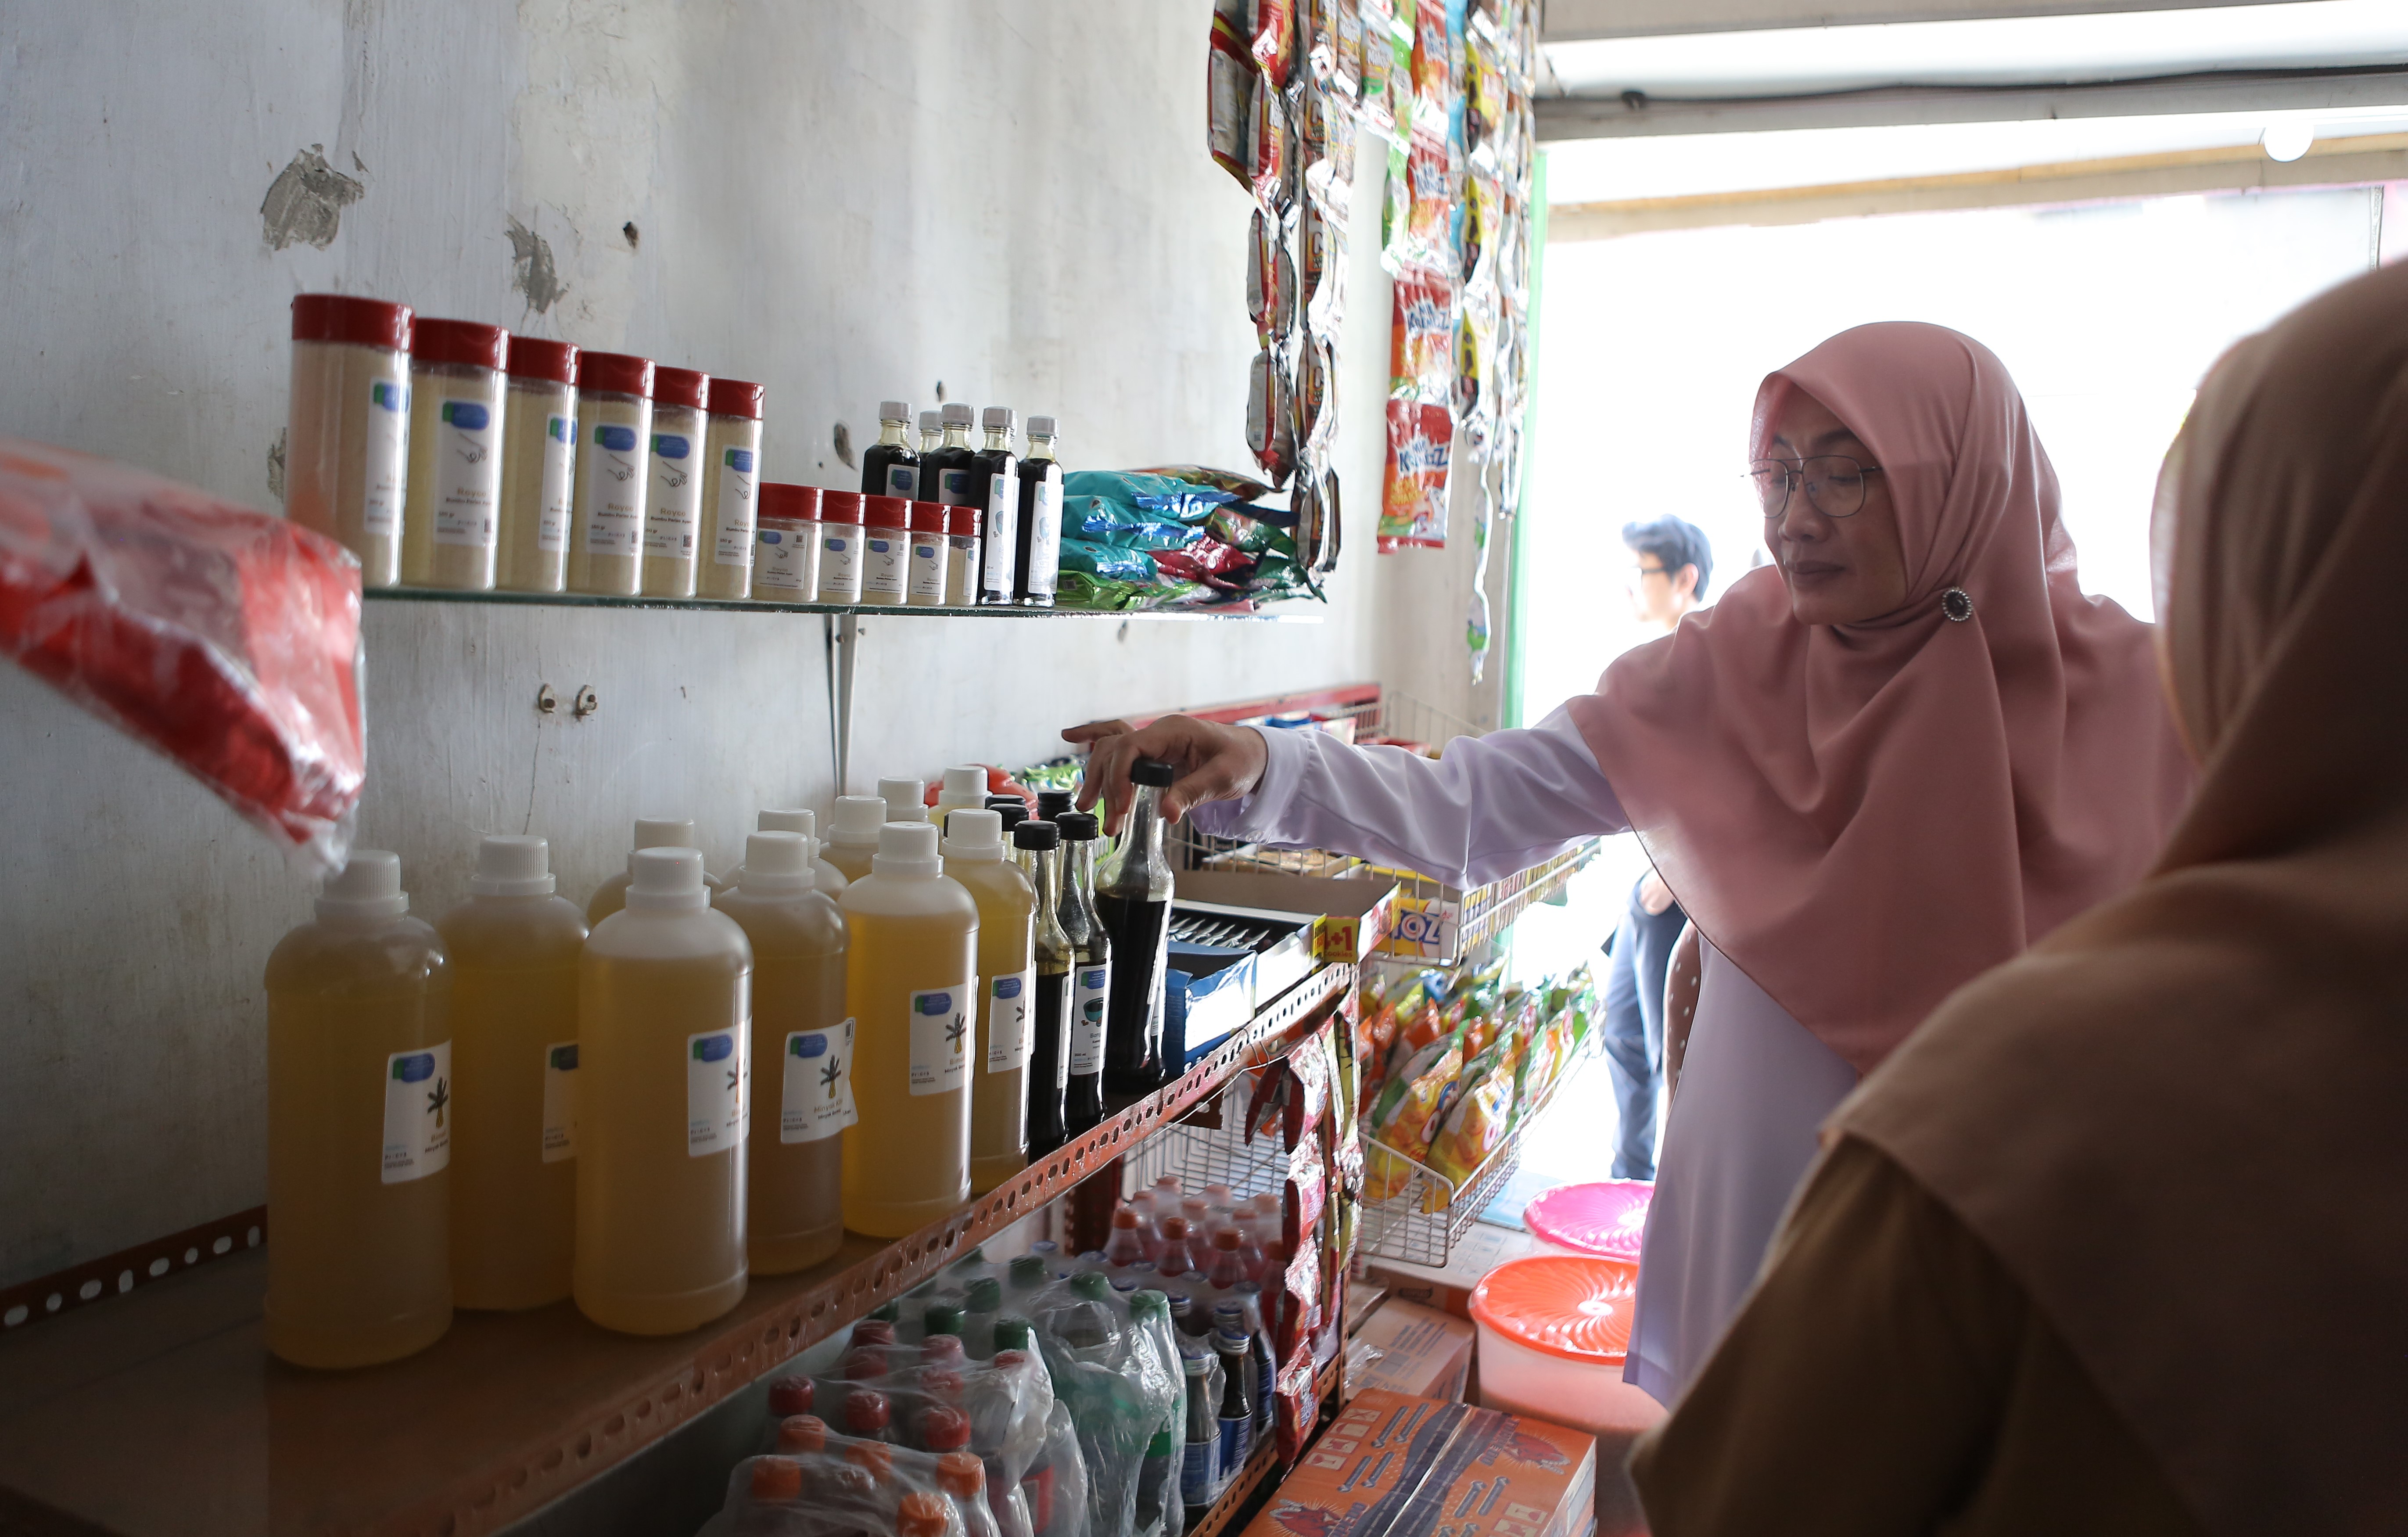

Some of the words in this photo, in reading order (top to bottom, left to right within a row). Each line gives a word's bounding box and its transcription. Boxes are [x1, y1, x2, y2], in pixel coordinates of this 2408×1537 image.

[607, 503, 633, 512] Royco
[660, 508, 686, 517] Royco
[814, 1102, 835, 1113] Minyak
